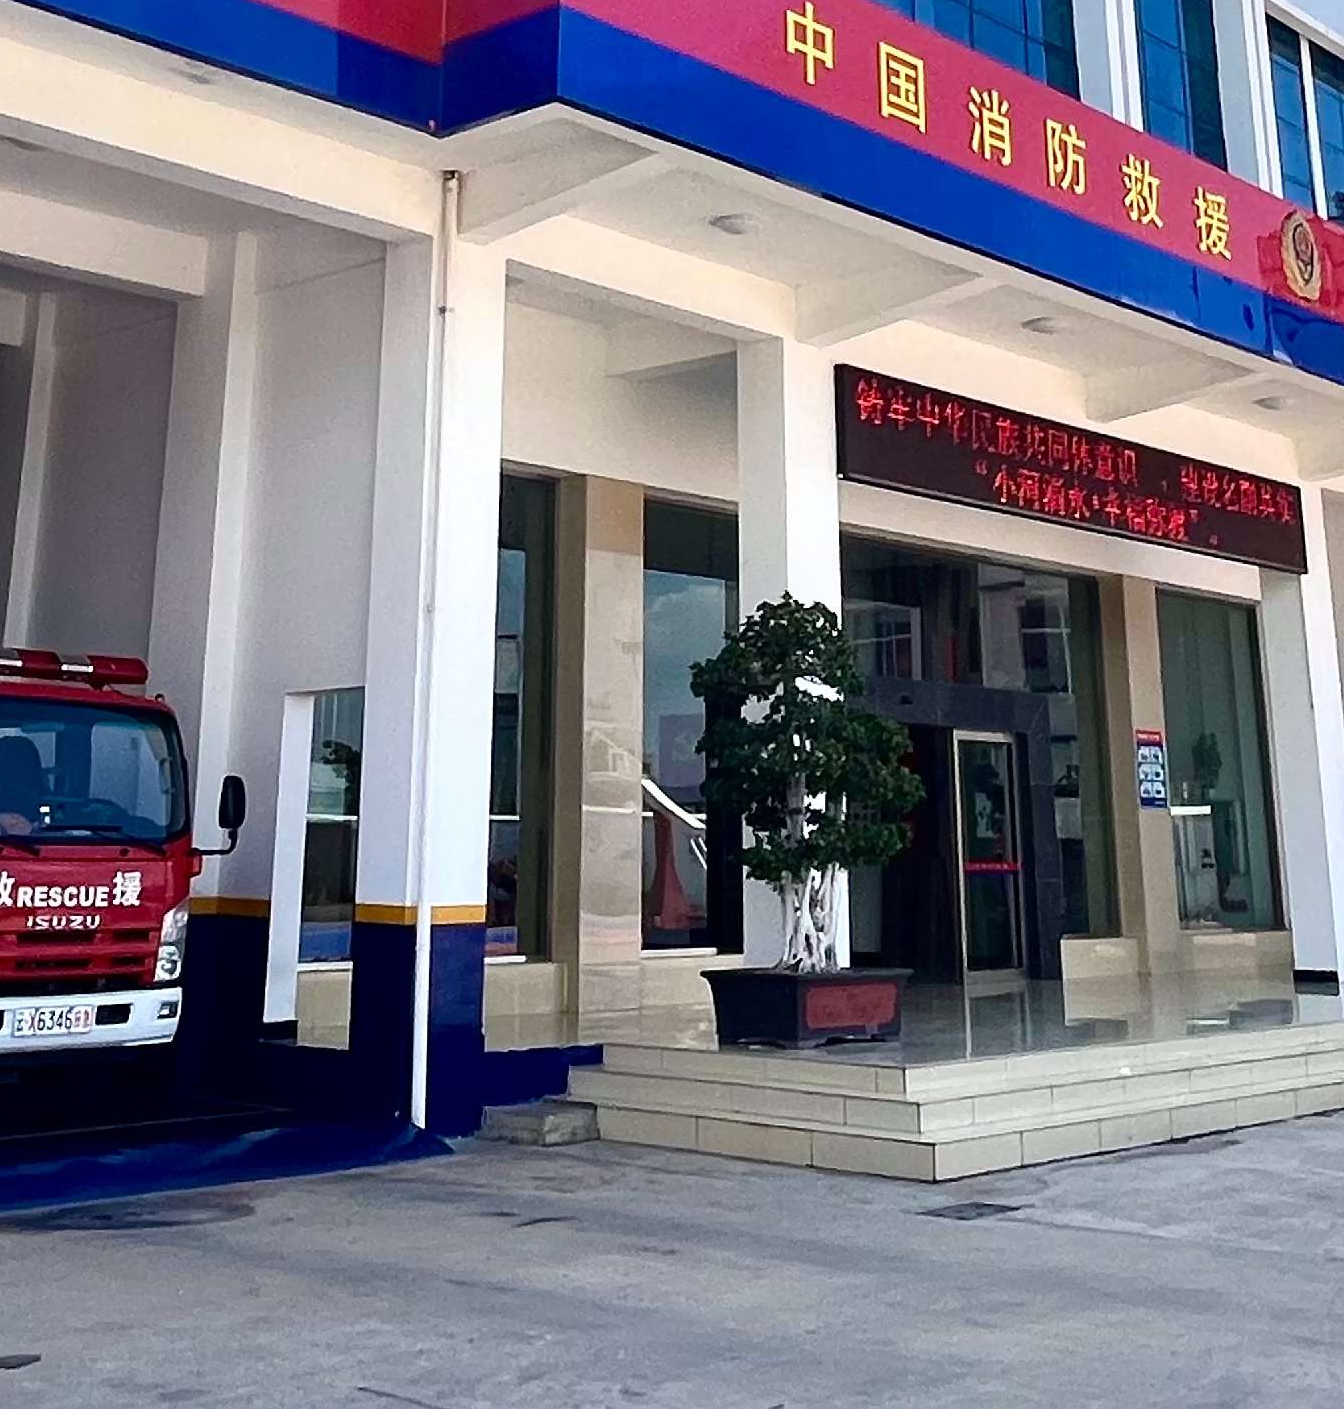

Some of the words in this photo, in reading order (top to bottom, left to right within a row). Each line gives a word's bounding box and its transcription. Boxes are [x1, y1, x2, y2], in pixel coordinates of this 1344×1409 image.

[785, 1, 1232, 260] 中国消防救援
[17, 886, 110, 907] RESCUE
[112, 871, 142, 907] 援
[27, 914, 100, 929] ISUZU
